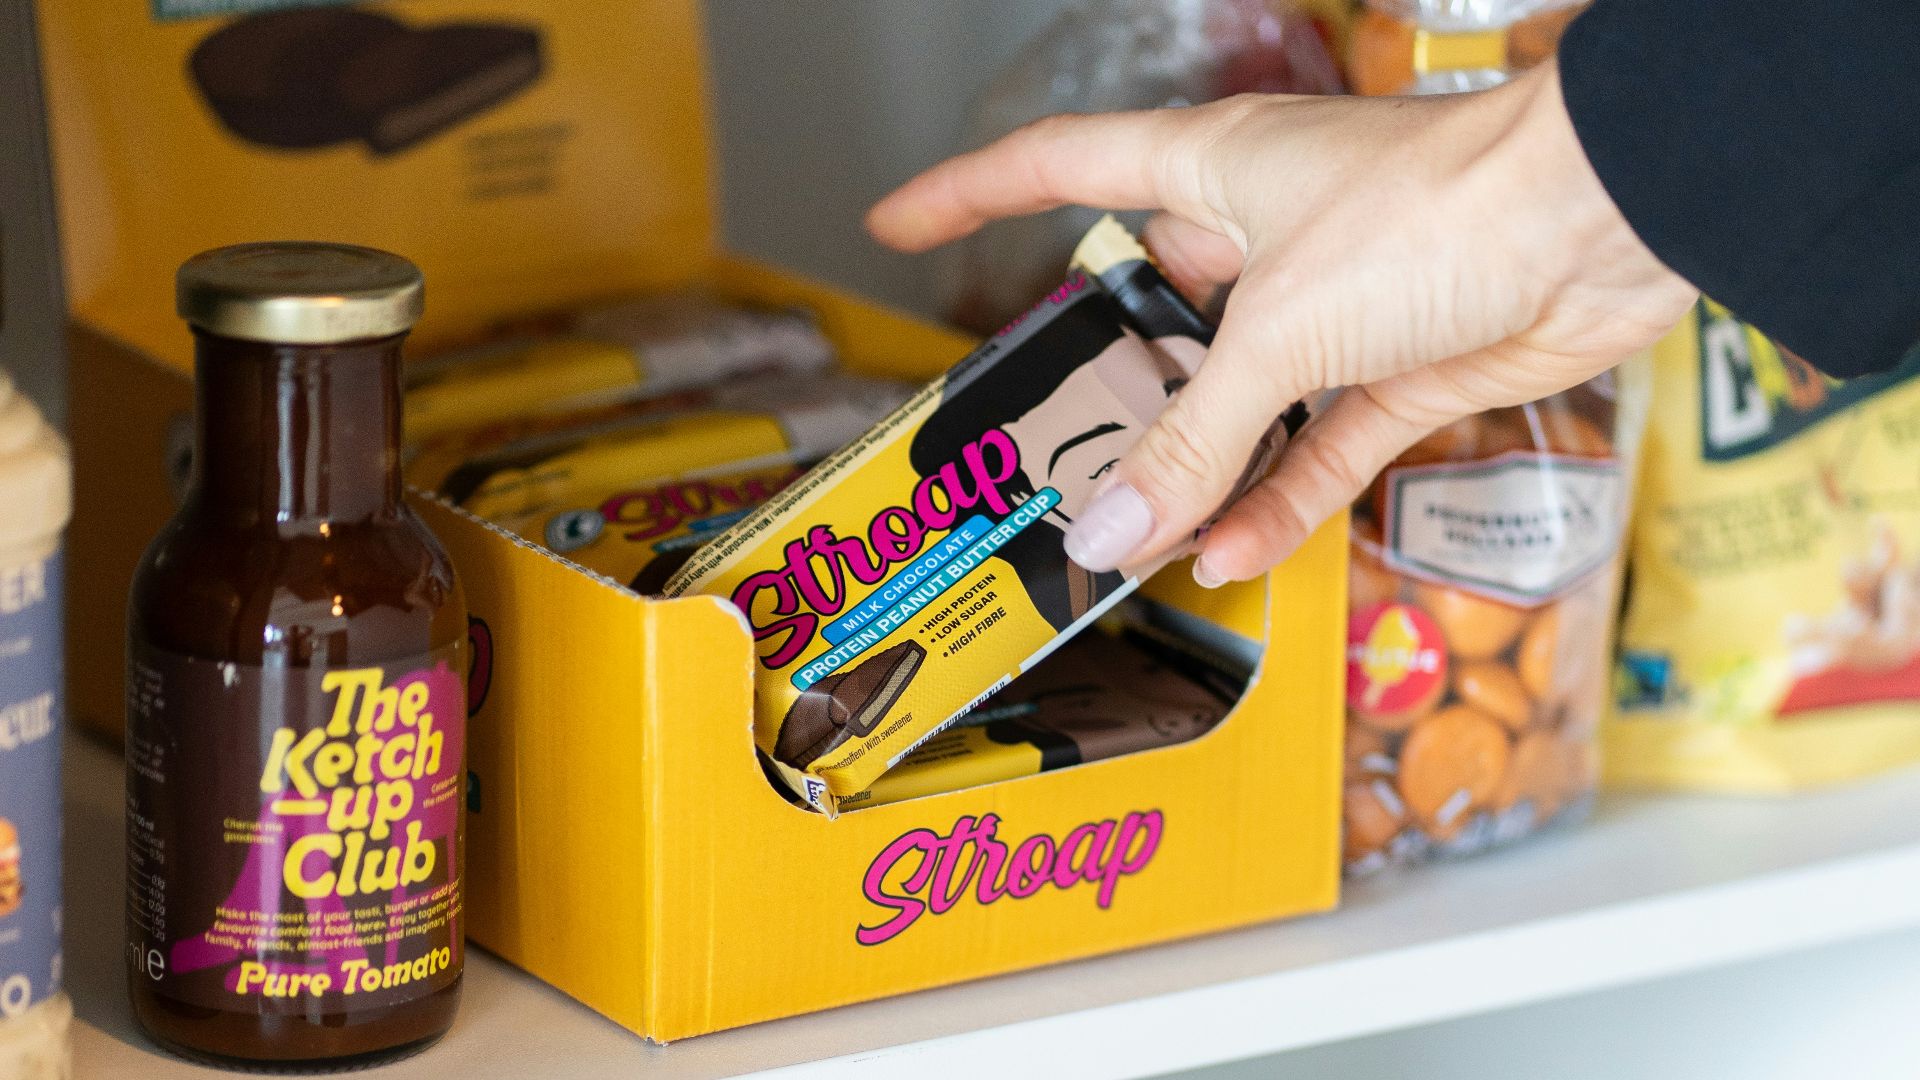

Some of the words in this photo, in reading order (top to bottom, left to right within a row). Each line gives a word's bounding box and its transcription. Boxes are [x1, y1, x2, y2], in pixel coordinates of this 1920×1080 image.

[720, 527, 757, 558] chocolate
[732, 428, 1021, 669] Stroap
[753, 516, 771, 532] Milk
[687, 563, 709, 583] salty
[704, 552, 725, 571] with
[842, 600, 883, 631] MILK
[883, 529, 975, 601] CHOCOLATE
[801, 629, 879, 684] PROTEIN
[876, 576, 948, 633] PEANUT
[946, 525, 1016, 579] BUTTER
[1014, 494, 1052, 528] CUP
[923, 607, 952, 634] HIGH
[951, 573, 997, 613] PROTEIN
[936, 618, 961, 644] LOW
[957, 591, 998, 628] SUGAR
[949, 630, 977, 655] HIGH
[975, 606, 1008, 636] FIBRE
[321, 667, 430, 737] The
[260, 713, 444, 800] Ketch
[865, 732, 882, 752] With
[881, 711, 913, 742] sweetener
[282, 819, 436, 899] Club
[855, 809, 1164, 946] Stroap
[213, 920, 269, 936] favourite
[271, 925, 321, 937] comfort
[324, 922, 353, 936] food
[390, 913, 416, 928] Enjoy
[418, 900, 450, 920] together
[216, 906, 246, 921] Make
[249, 909, 270, 923] the
[272, 911, 304, 924] most
[307, 911, 321, 923] of
[323, 910, 351, 925] your
[385, 898, 417, 914] burger
[420, 895, 429, 904] or
[297, 933, 384, 951] almost-friends
[385, 926, 404, 942] and
[405, 915, 445, 937] imaginary
[236, 960, 332, 998] Pure
[341, 946, 450, 995] Tomato
